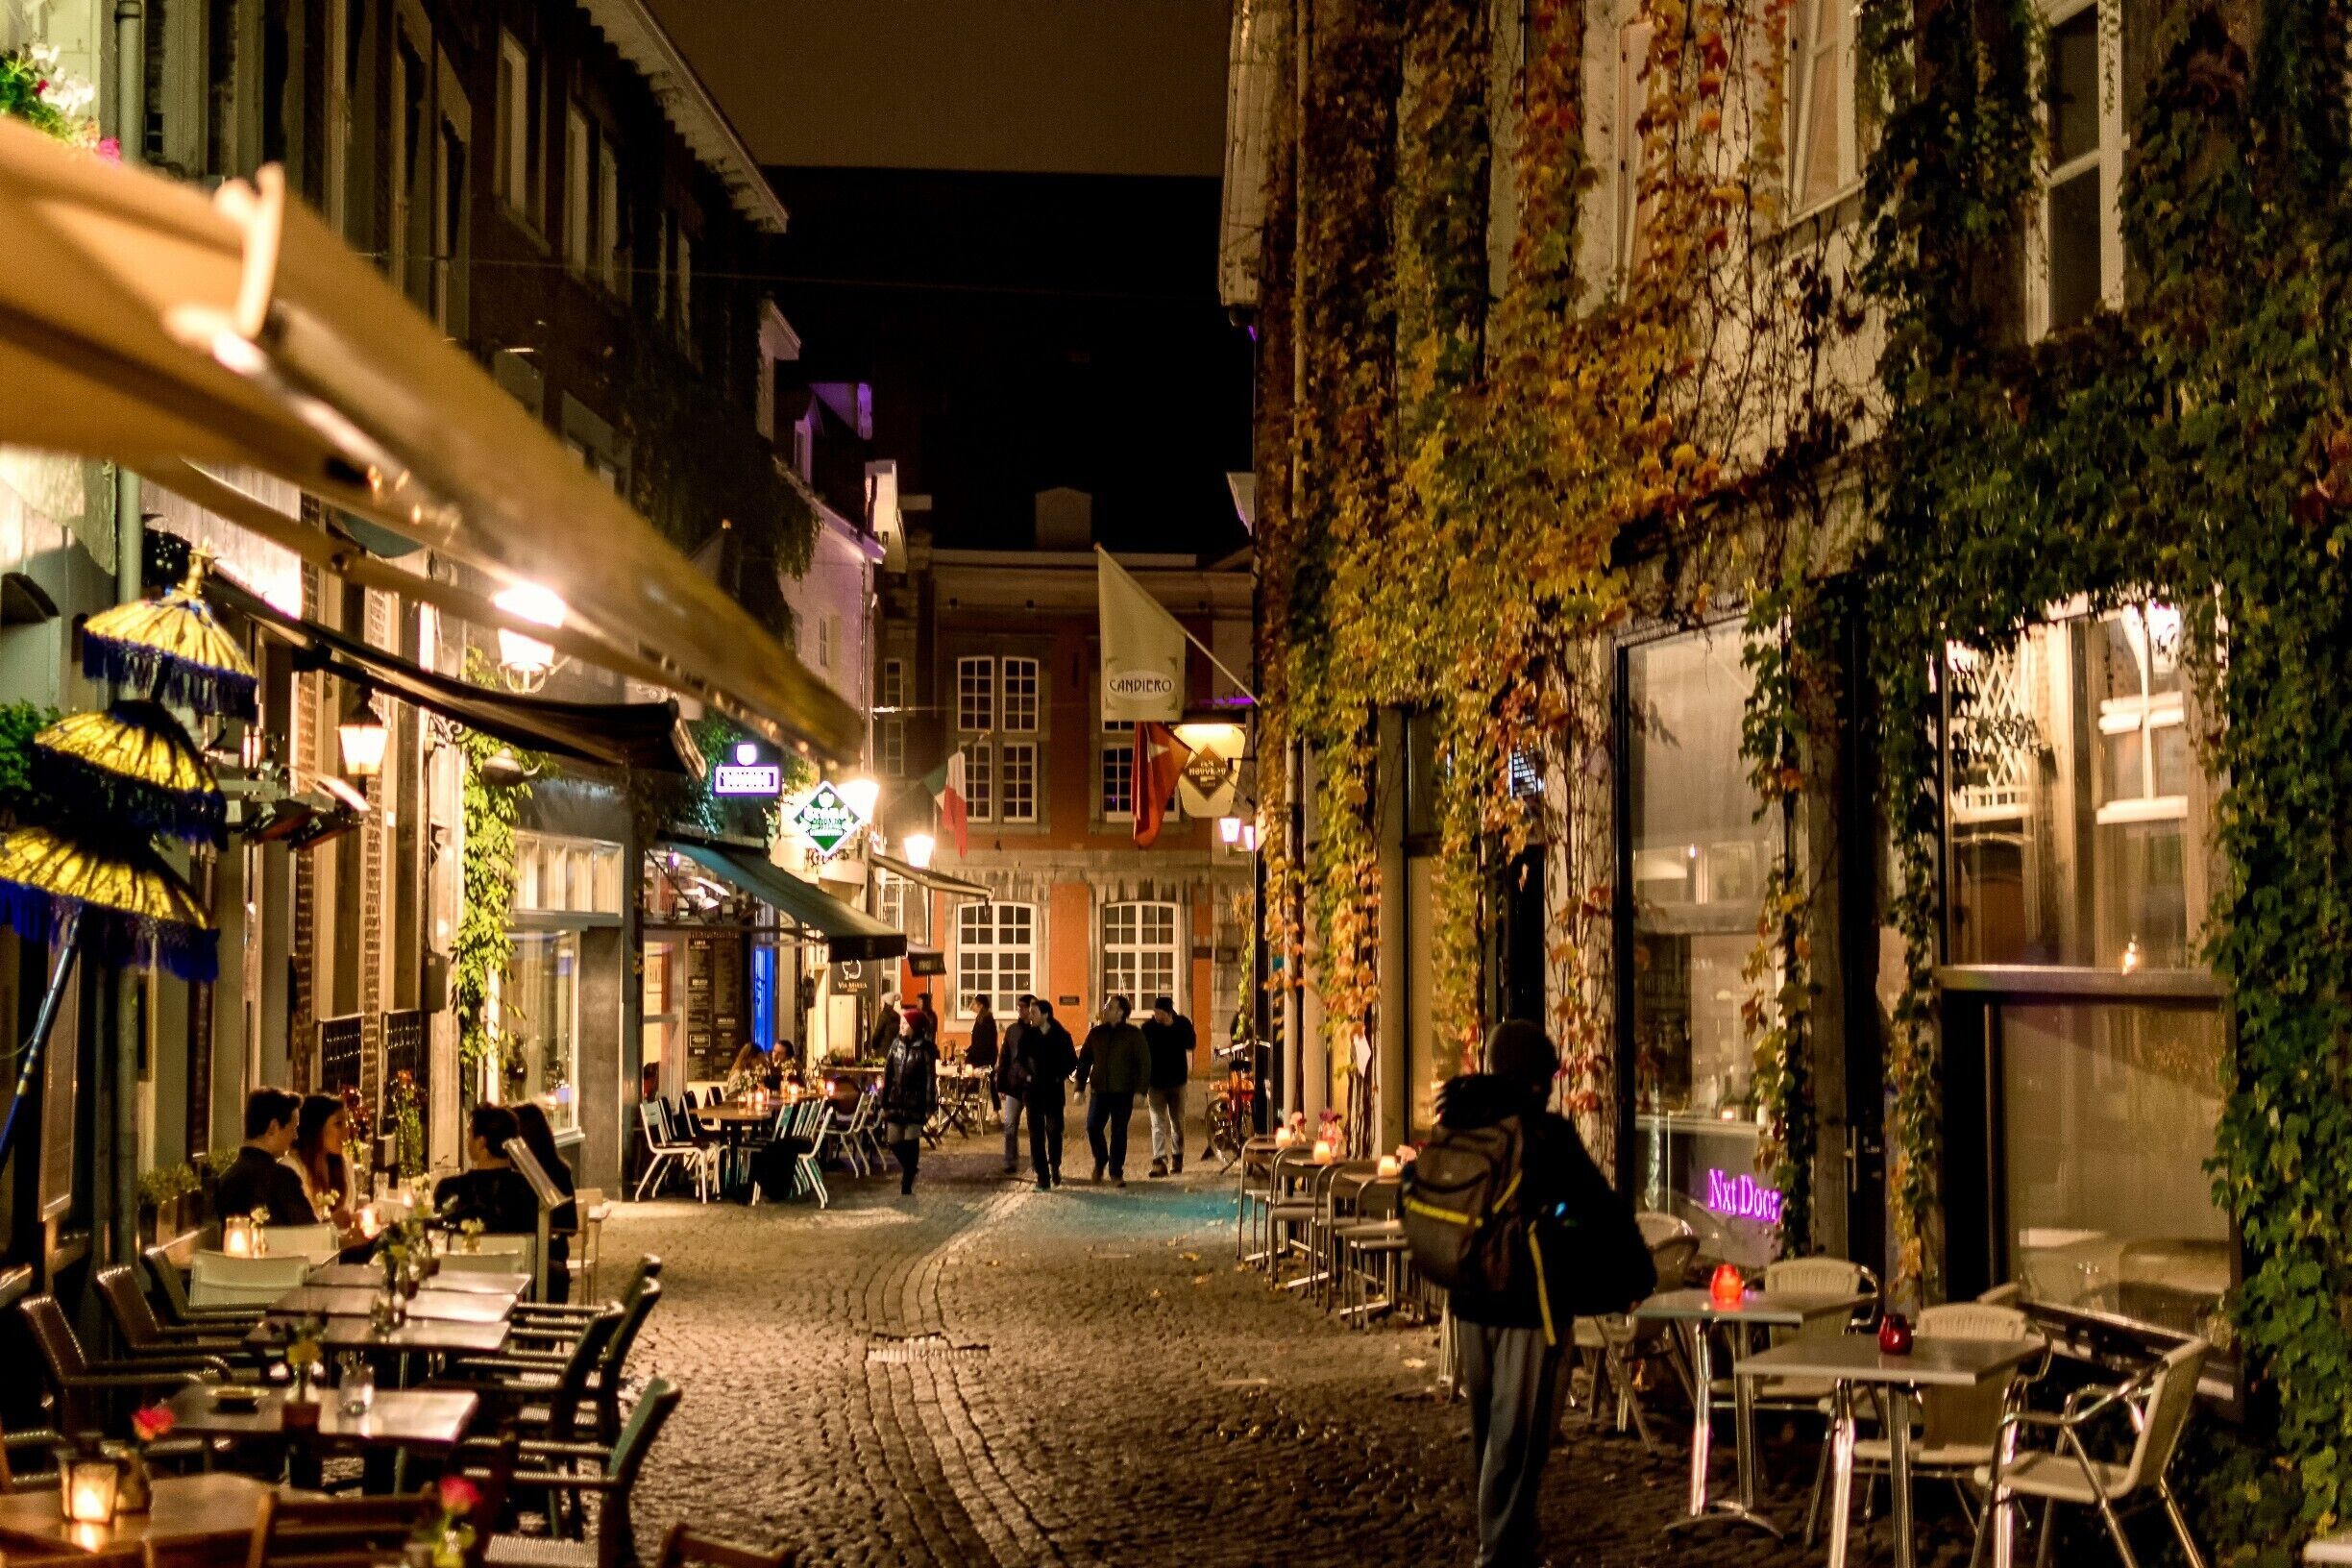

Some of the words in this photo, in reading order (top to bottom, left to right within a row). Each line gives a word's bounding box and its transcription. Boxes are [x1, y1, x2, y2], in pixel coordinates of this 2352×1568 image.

[1109, 677, 1172, 693] CANDIERO
[1708, 1168, 1737, 1214] Nxt
[1740, 1174, 1780, 1221] Door
